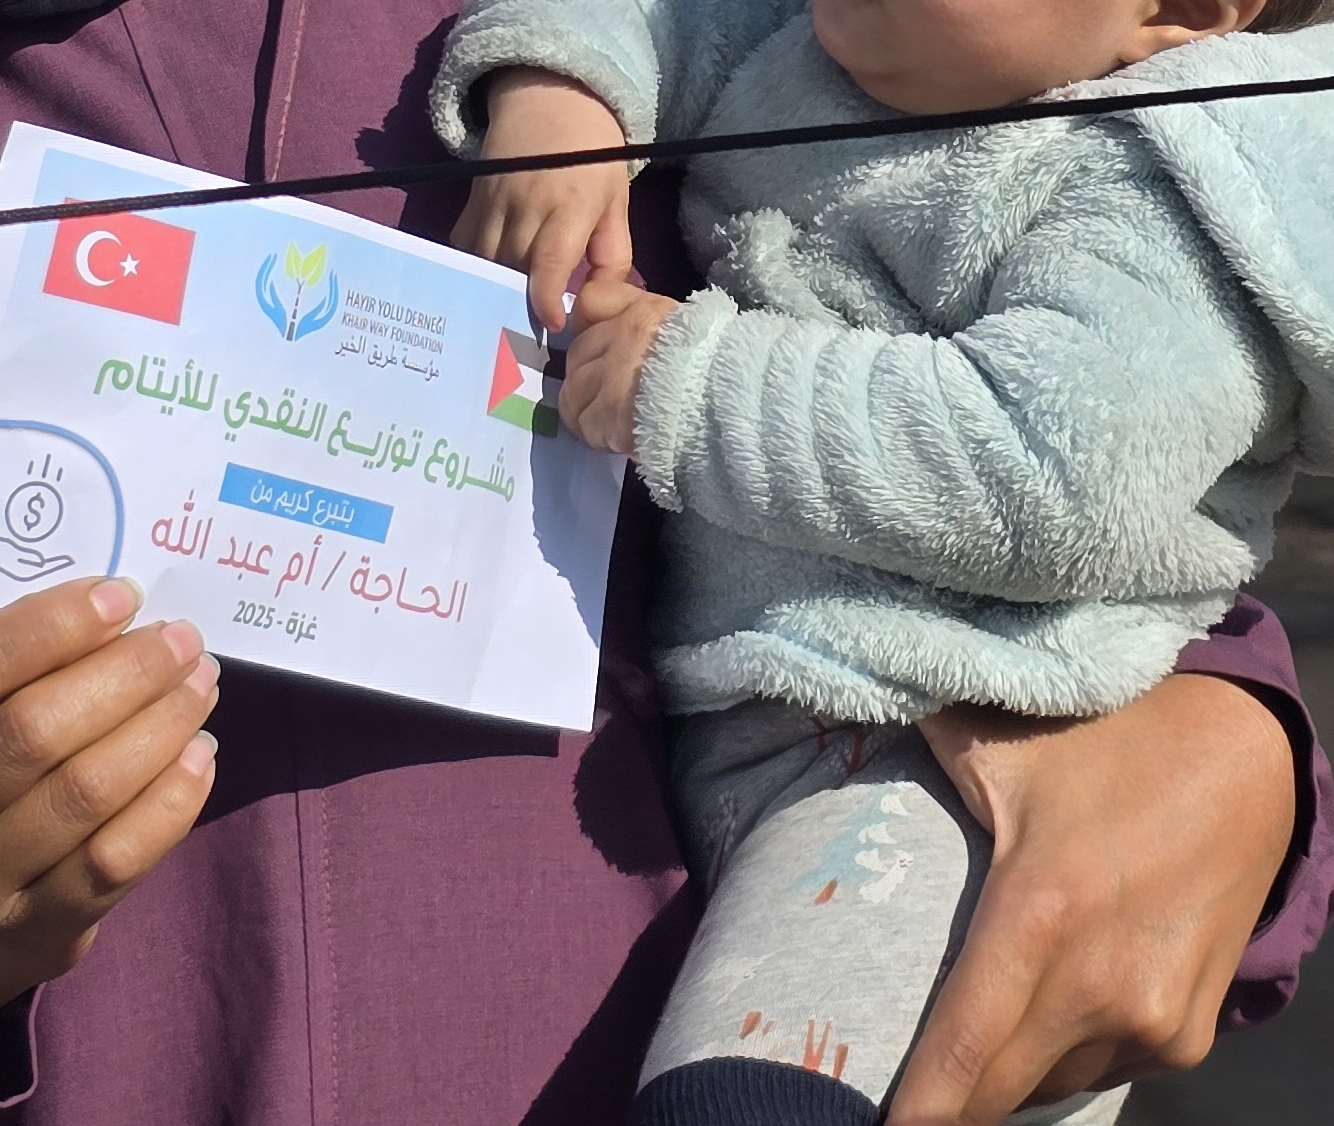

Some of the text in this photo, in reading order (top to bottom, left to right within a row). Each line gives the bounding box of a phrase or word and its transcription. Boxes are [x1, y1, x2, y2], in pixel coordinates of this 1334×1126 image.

[345, 289, 376, 314] HAYIR
[378, 299, 405, 323] YOLU
[334, 334, 367, 357] الخير
[341, 311, 444, 355] KHAIR WAY FOUNDATION
[367, 344, 398, 369] طريق
[93, 354, 516, 503] مشروع توزيع النقدي للأيتام
[150, 488, 214, 560] الله
[249, 478, 355, 529] بتبرع كريم من
[216, 535, 274, 582] عبد
[273, 533, 324, 599] أم
[349, 554, 468, 623] الحاجة
[231, 599, 276, 630] 2025
[284, 610, 318, 644] غزة
